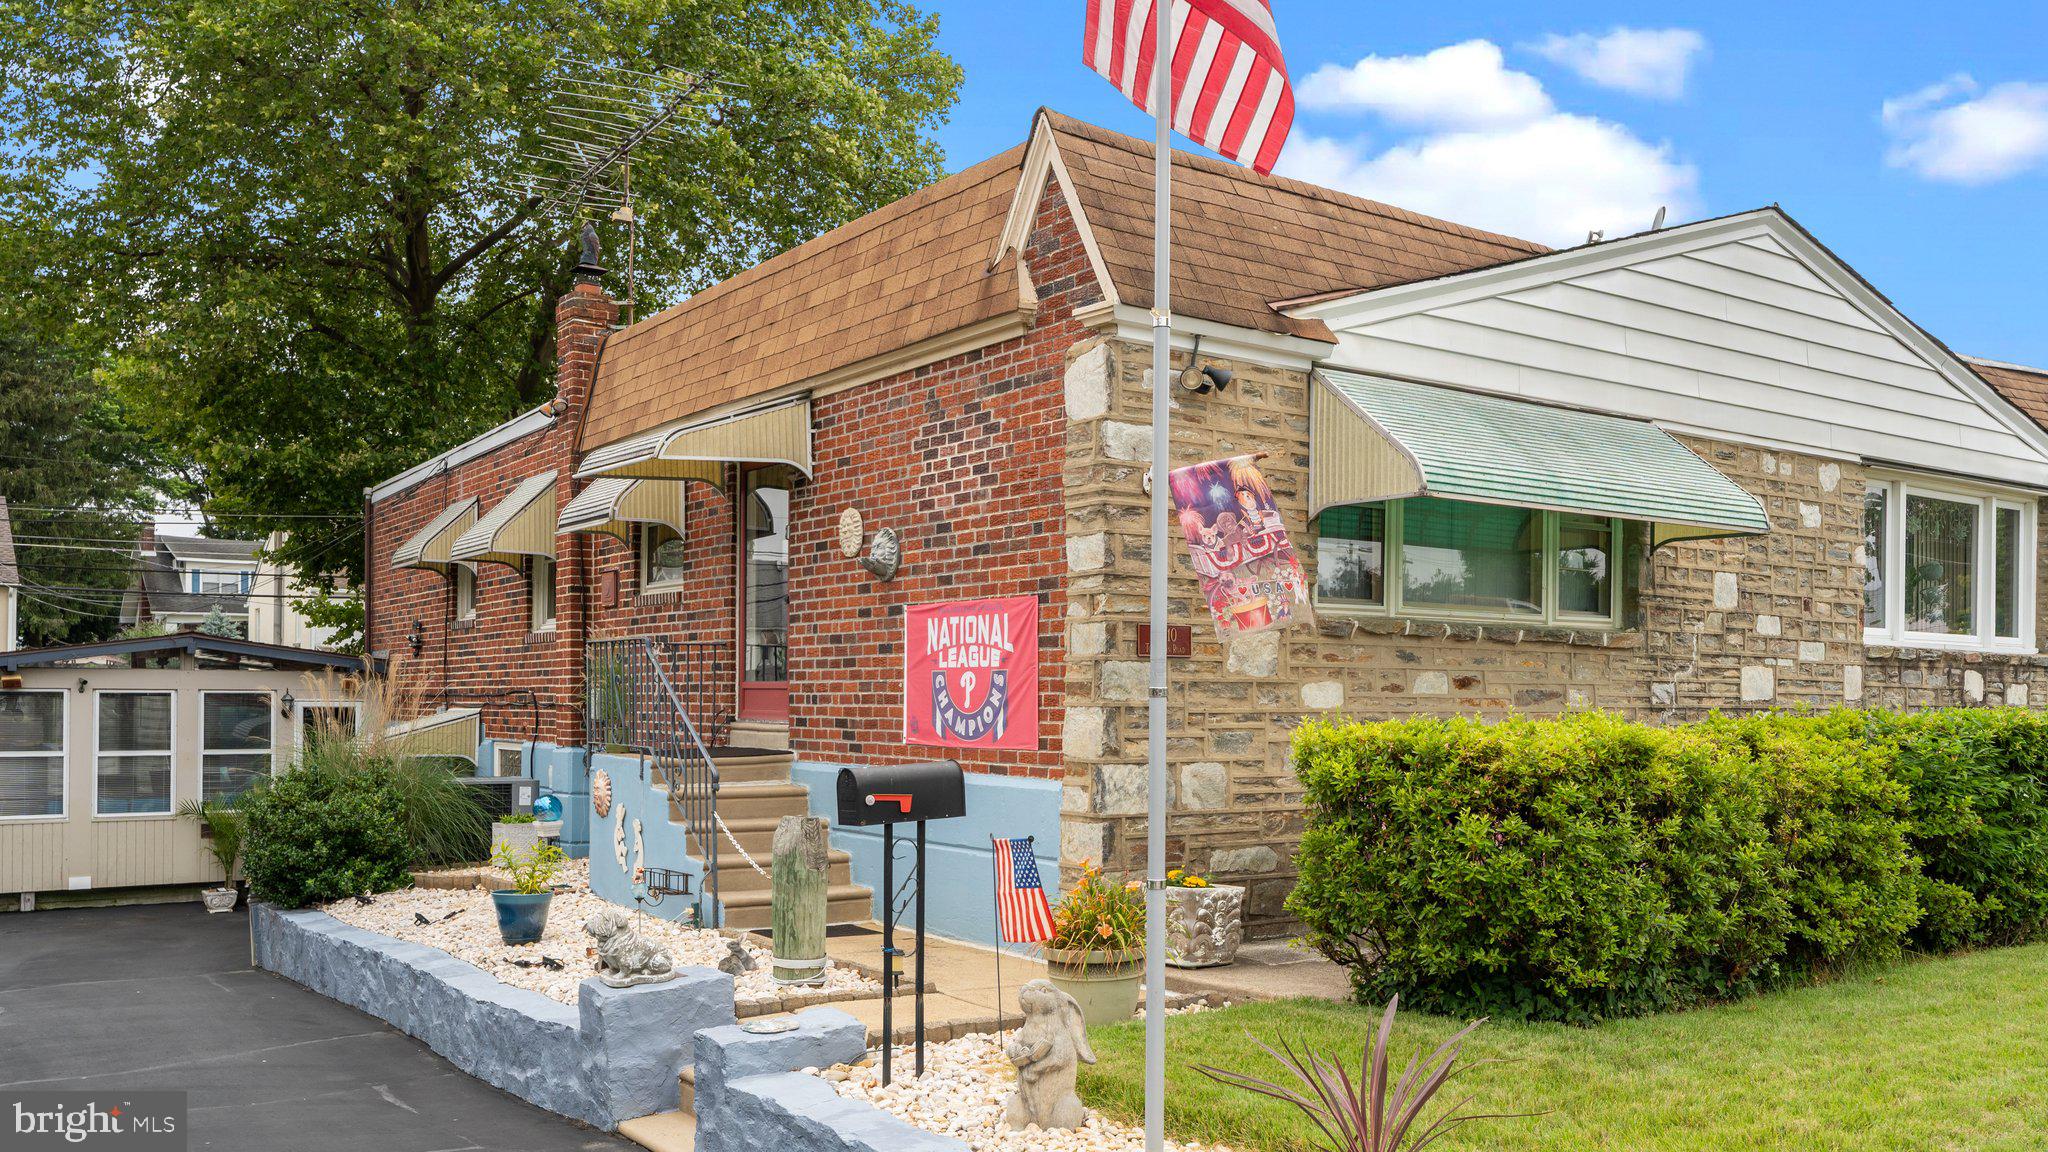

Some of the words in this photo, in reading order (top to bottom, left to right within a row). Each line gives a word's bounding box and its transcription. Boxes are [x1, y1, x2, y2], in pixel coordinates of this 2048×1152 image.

[1251, 582, 1284, 595] USA
[927, 612, 1014, 656] NATIONAL
[938, 645, 1003, 669] LEAGUE
[934, 673, 1006, 737] CHAMPIONS
[959, 670, 977, 709] P
